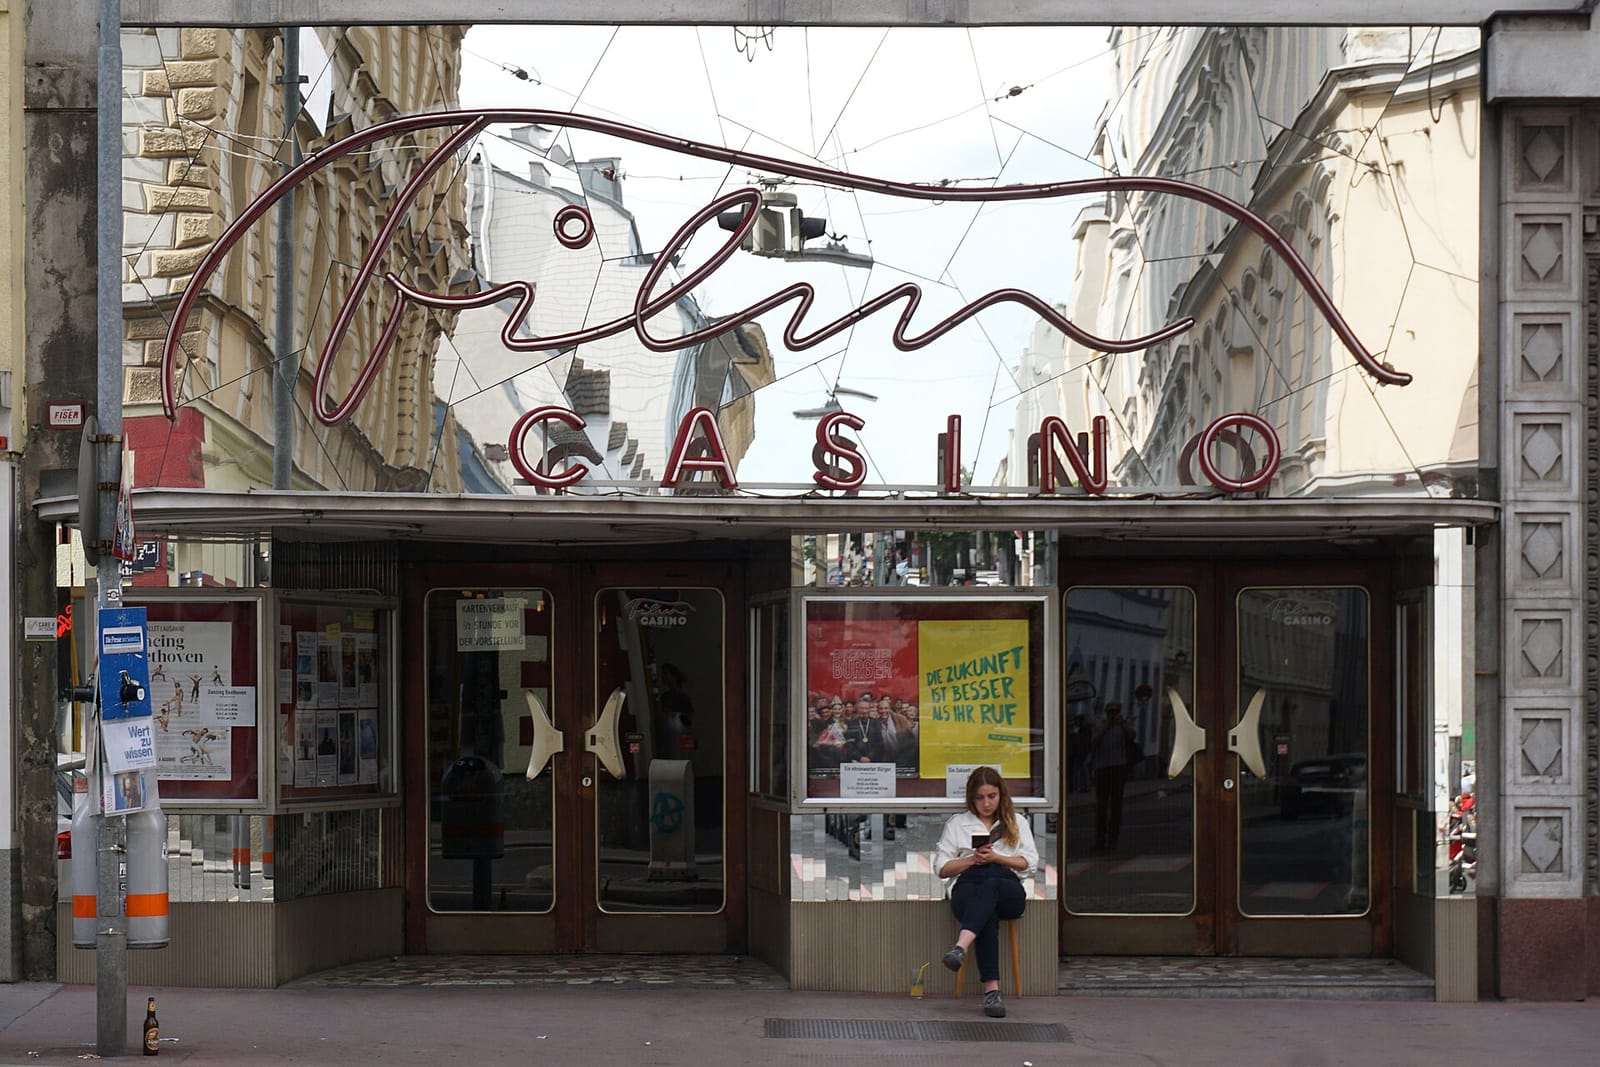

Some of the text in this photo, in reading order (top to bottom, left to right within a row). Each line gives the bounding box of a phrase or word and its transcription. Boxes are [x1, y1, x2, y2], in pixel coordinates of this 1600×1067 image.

[508, 405, 1281, 495] CASINO
[474, 620, 502, 630] STUNDE
[504, 619, 519, 629] VOR
[641, 616, 687, 625] CASINO
[1284, 615, 1332, 625] CASINO
[147, 635, 185, 650] cing
[459, 637, 473, 646] DER
[147, 649, 204, 663] thoven
[926, 646, 1024, 686] DIE ZUKUNFT
[931, 676, 1015, 703] IST BESSER
[932, 703, 1018, 725] ALS IHR RUF
[128, 726, 150, 738] Wert
[141, 738, 152, 748] zu
[124, 747, 153, 760] wissen
